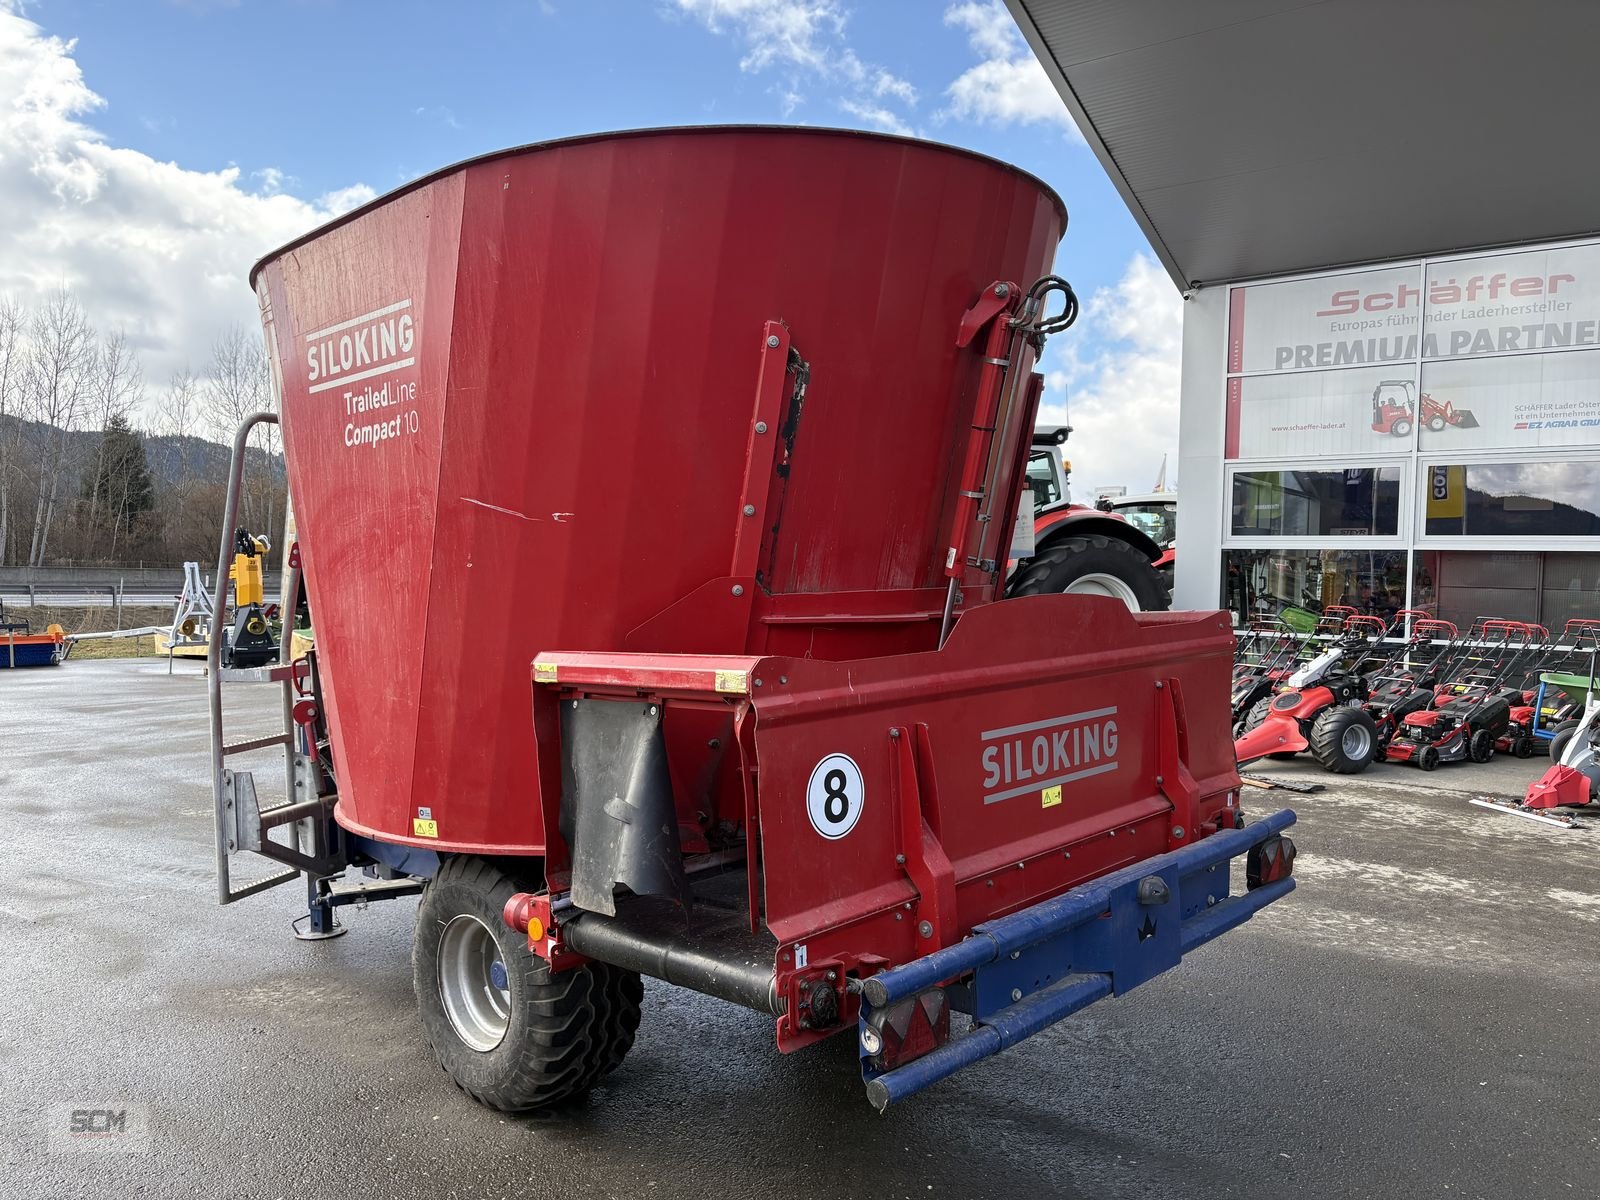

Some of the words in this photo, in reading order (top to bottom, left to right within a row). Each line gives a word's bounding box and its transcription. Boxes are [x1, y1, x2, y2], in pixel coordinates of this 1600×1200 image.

[1316, 273, 1575, 317] Schäffer
[1330, 319, 1383, 332] Europas
[1387, 311, 1457, 327] führnder
[1462, 300, 1572, 320] Laderhersteller
[307, 314, 413, 381] SILOKING
[1276, 333, 1439, 369] PREMIUM
[1450, 320, 1600, 355] PARTNE
[344, 379, 416, 415] TrailedLine
[1540, 409, 1596, 419] Unternehmen
[345, 414, 401, 448] Compact
[404, 410, 419, 434] 10
[1544, 420, 1578, 429] AGRAR
[982, 720, 1119, 789] SILOKING
[824, 769, 849, 823] 8
